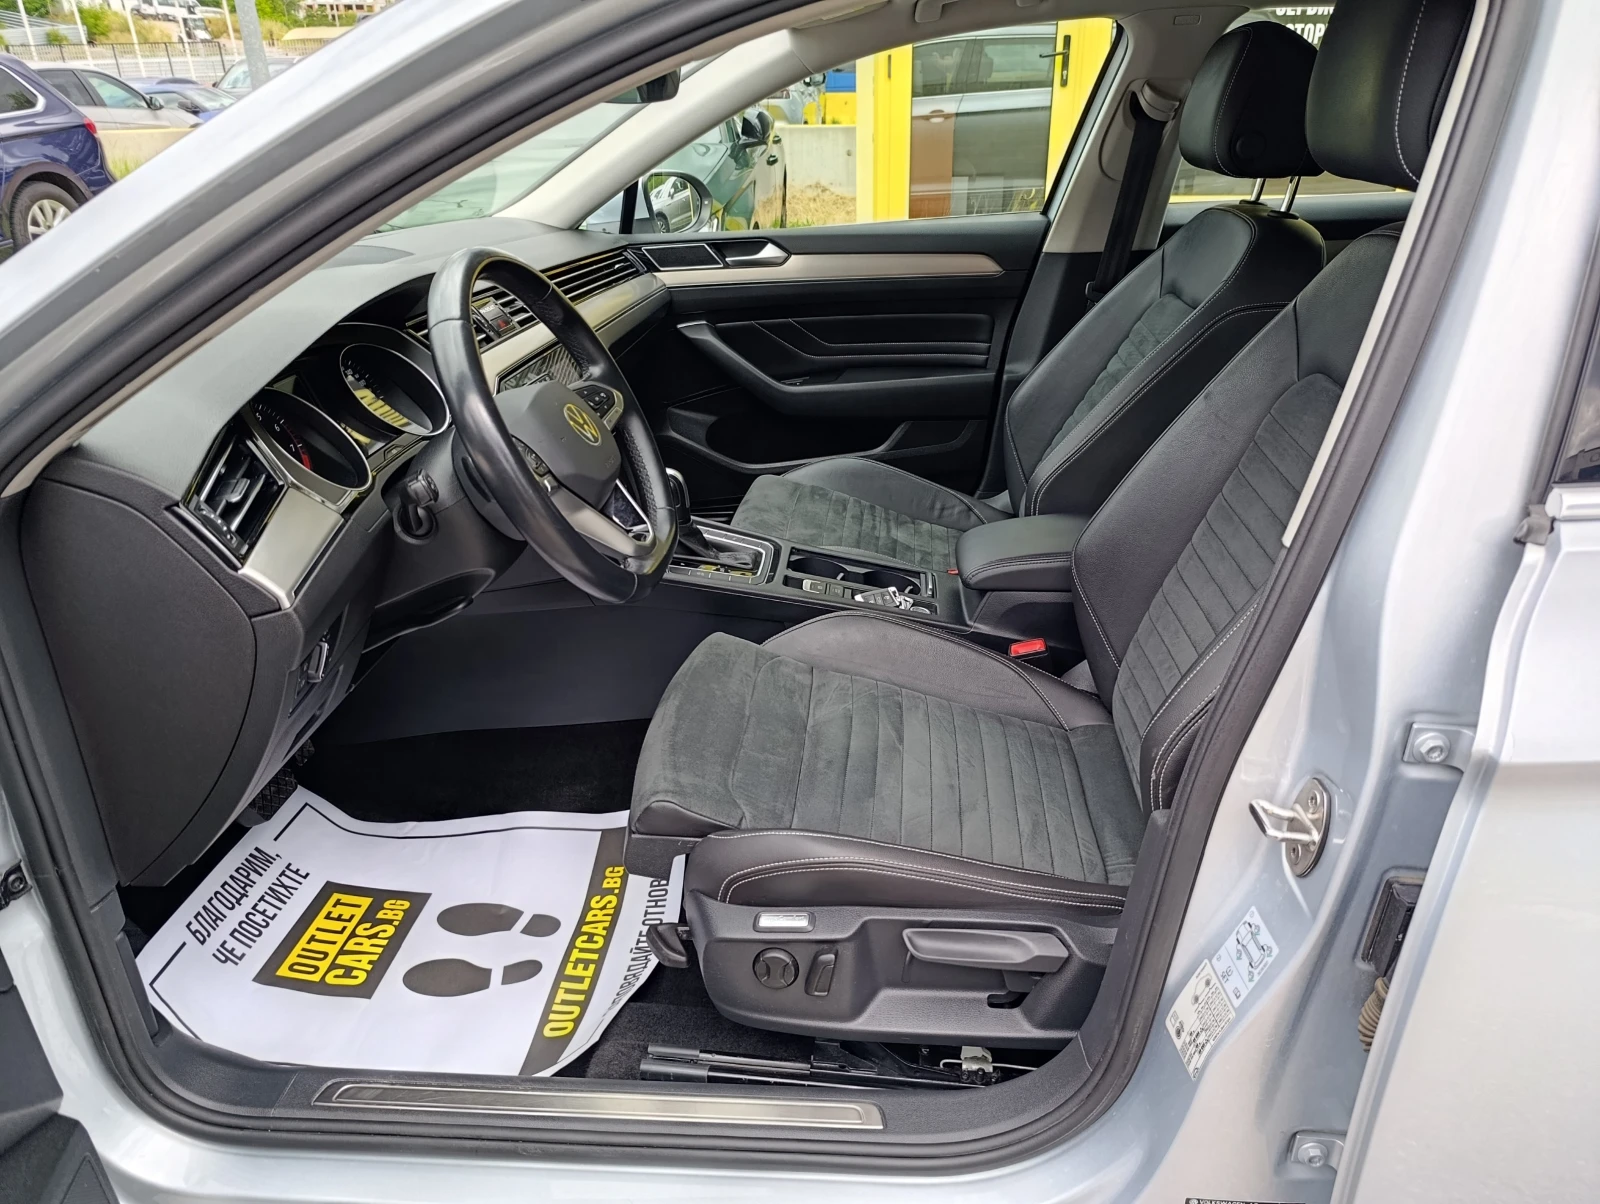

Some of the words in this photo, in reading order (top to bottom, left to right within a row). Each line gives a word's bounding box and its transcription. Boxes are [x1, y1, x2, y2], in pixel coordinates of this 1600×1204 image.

[274, 423, 281, 432] 6
[289, 443, 296, 452] 7
[185, 846, 282, 946] БЛАГОДАРИМ,
[229, 862, 310, 949] ПОСЕТИХТЕ
[642, 879, 669, 928] ОТНОВ
[212, 940, 247, 966] ЧЕ
[288, 898, 362, 975] OUTLET
[325, 899, 411, 986] CARS.BG
[543, 866, 625, 1038] OUTLETCARS.BG
